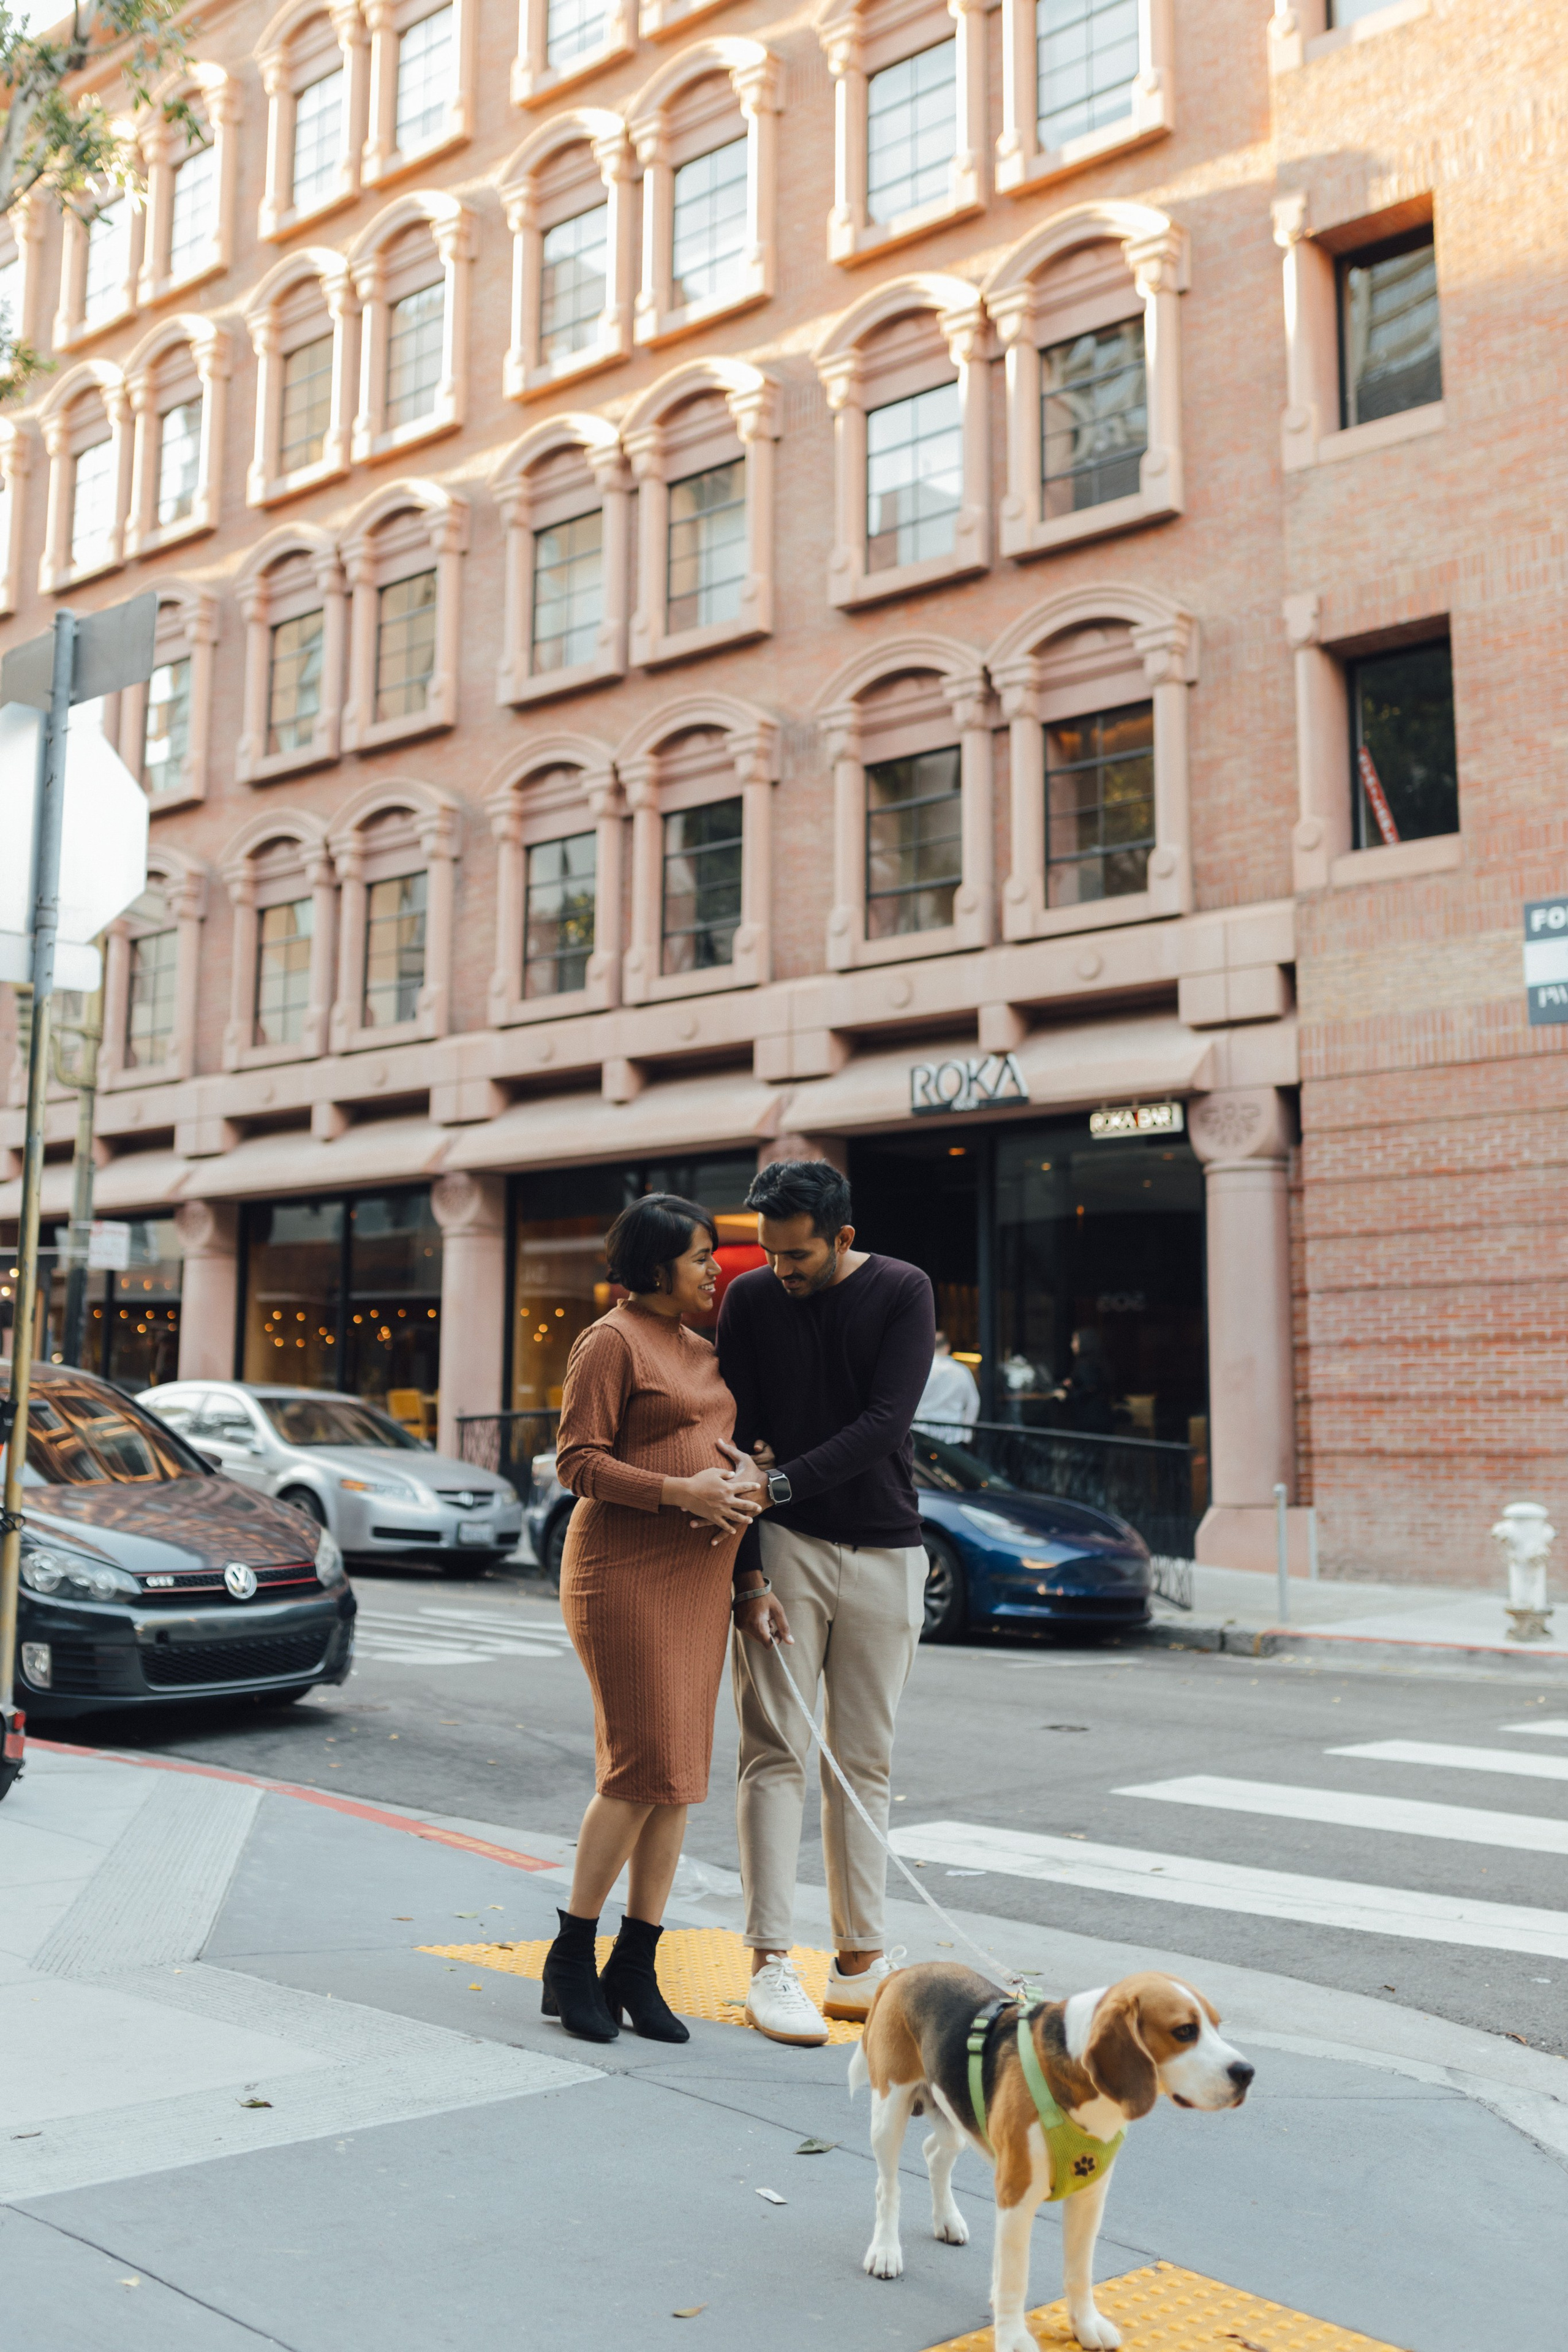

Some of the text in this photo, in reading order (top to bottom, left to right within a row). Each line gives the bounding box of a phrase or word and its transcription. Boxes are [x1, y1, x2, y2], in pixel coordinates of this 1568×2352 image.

[1532, 905, 1568, 932] FO
[912, 1052, 1029, 1108] ROKA
[1090, 1106, 1172, 1133] ROKA BAR
